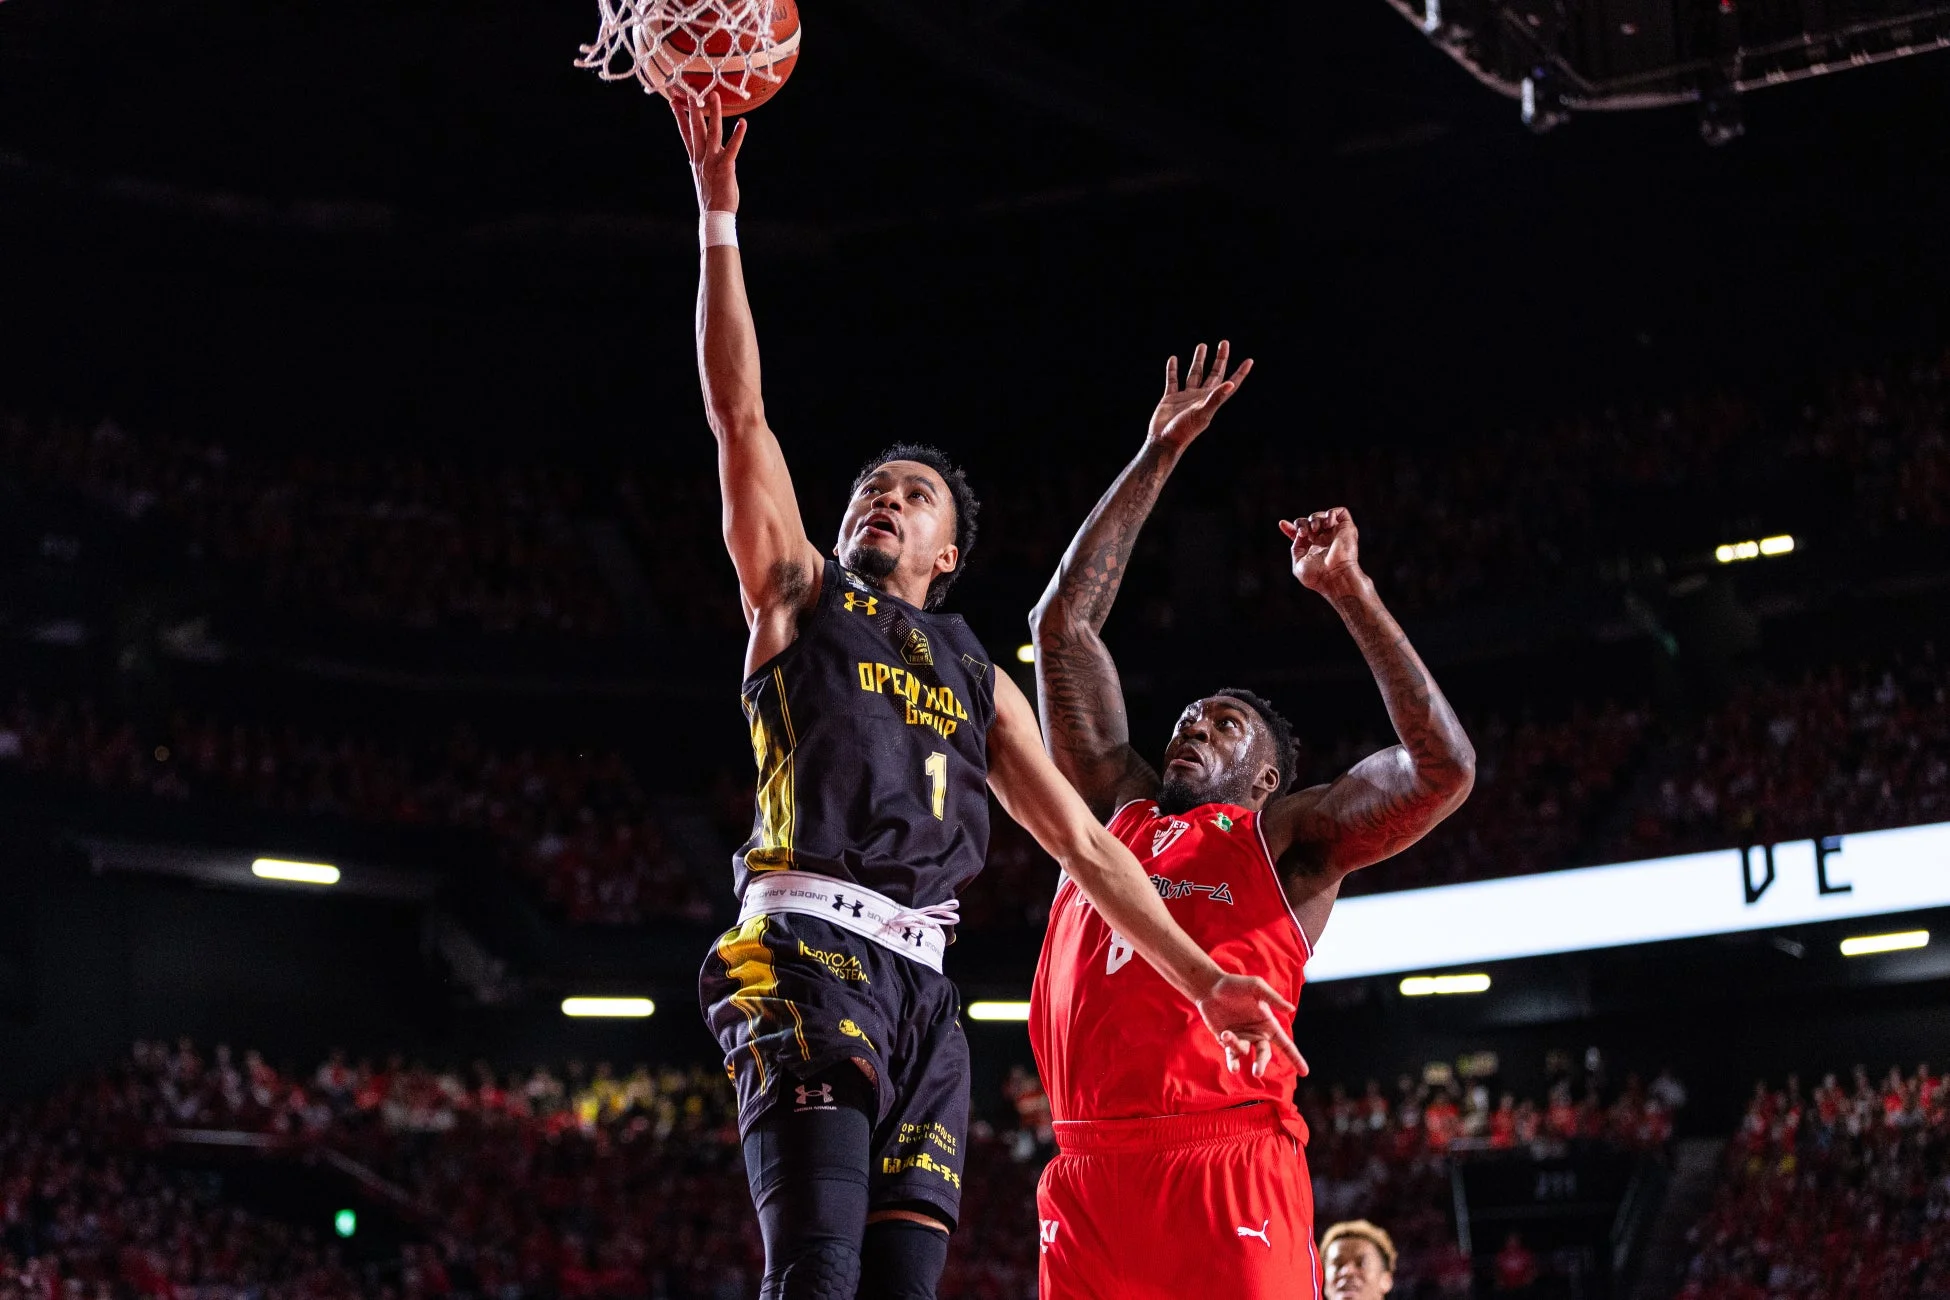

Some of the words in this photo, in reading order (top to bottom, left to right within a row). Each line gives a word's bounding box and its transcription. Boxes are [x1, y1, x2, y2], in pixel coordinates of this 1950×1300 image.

[858, 662, 920, 705] OPEN
[925, 752, 946, 821] 1
[789, 889, 829, 902] UNDER
[827, 965, 871, 984] SYSTEM
[901, 1123, 930, 1133] OPEN
[934, 1122, 957, 1147] HOUSE
